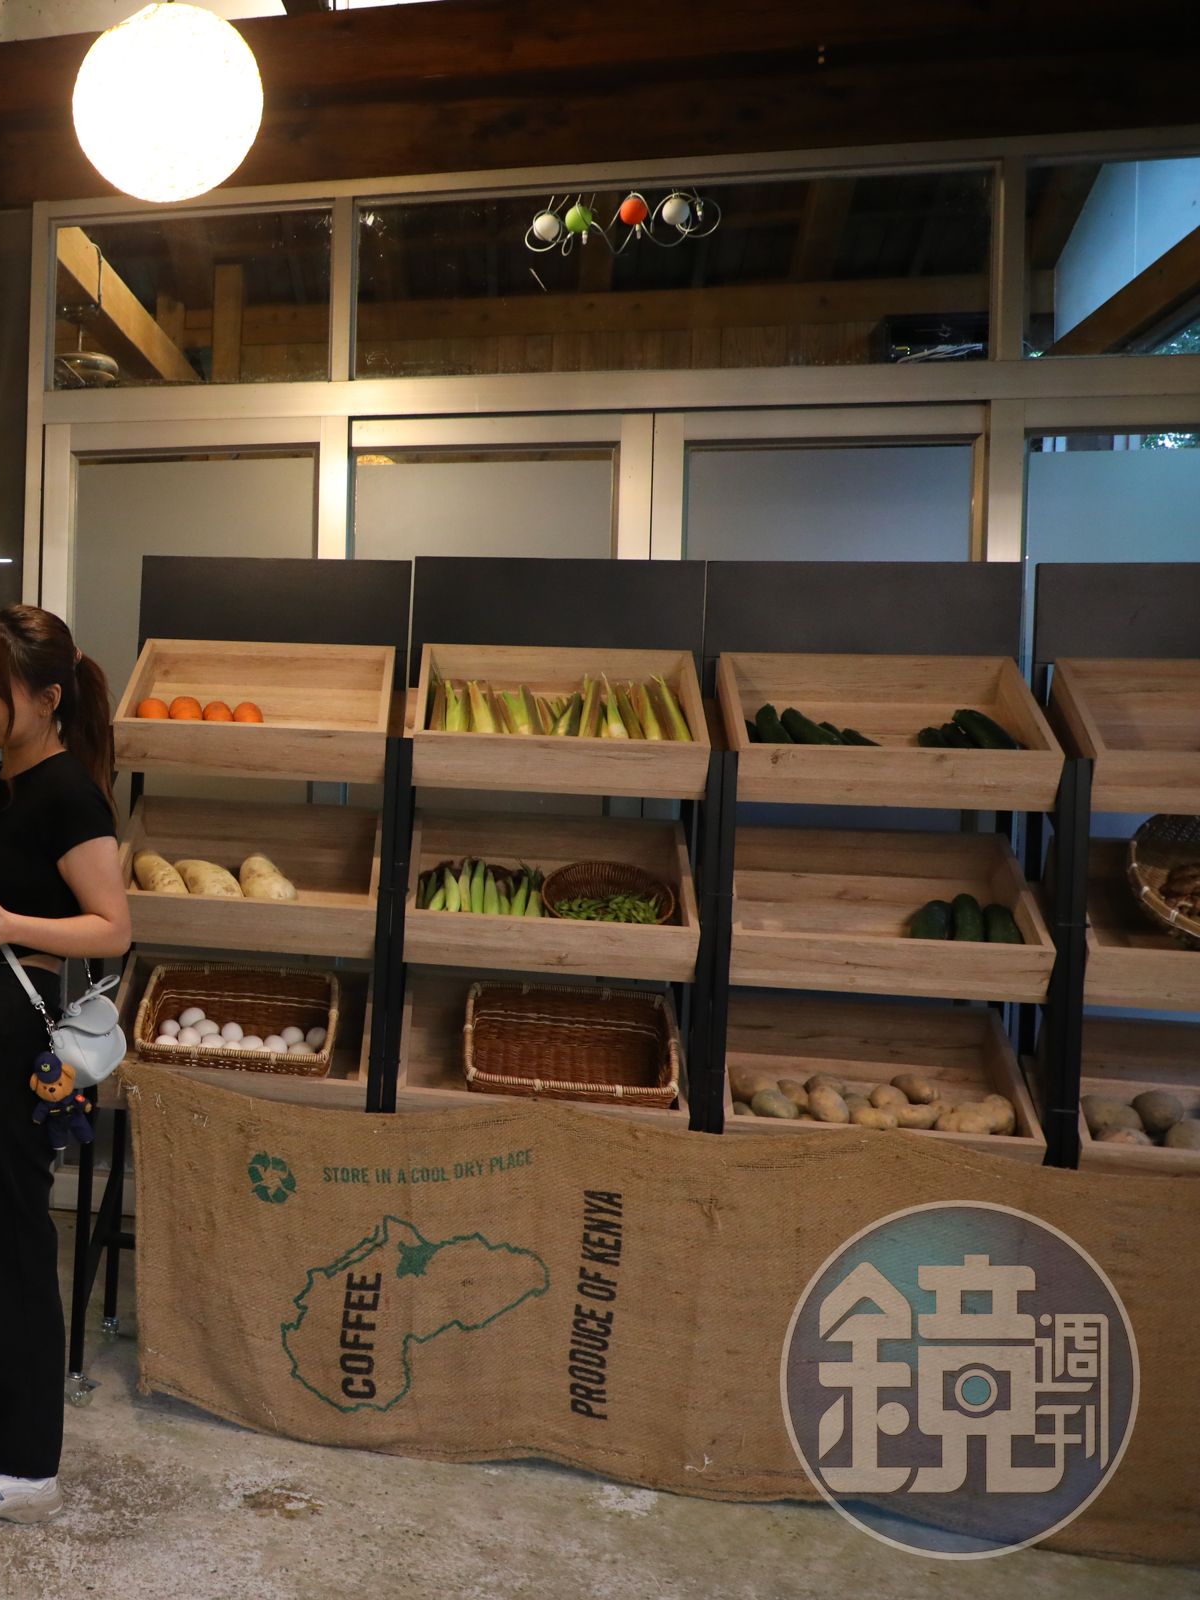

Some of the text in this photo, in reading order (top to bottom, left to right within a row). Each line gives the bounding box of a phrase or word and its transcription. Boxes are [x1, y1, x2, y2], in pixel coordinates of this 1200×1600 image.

[322, 1149, 534, 1184] STORE IN A COOL DRY PLACE
[339, 1272, 382, 1400] COFFEE
[568, 1189, 623, 1421] PRODUCE OF KENYA
